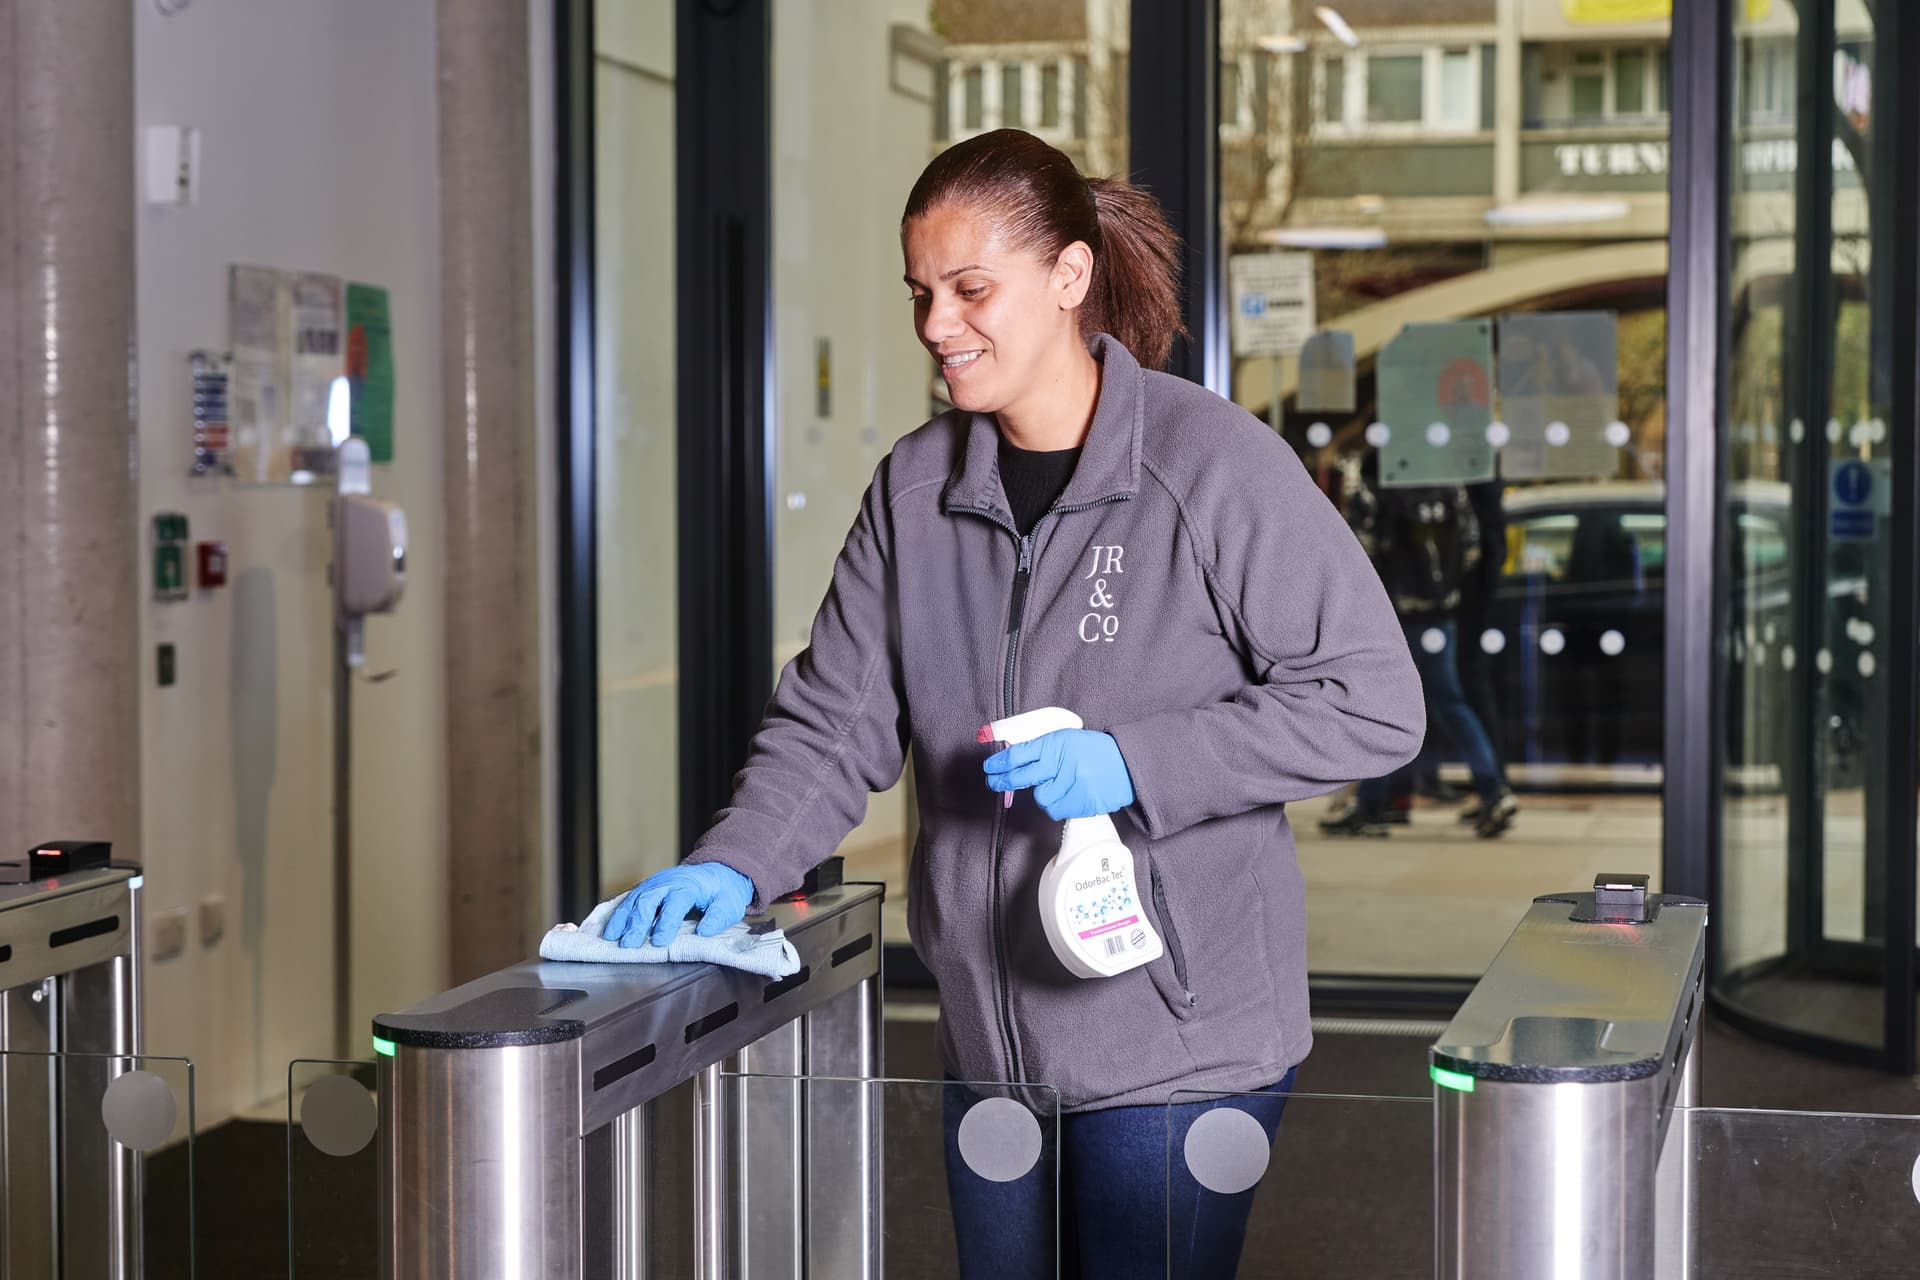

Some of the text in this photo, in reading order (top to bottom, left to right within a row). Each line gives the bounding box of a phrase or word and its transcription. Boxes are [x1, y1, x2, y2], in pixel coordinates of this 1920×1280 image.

[1085, 545, 1124, 579] JR
[1089, 578, 1114, 608] &
[1075, 876, 1111, 891] OdorBac
